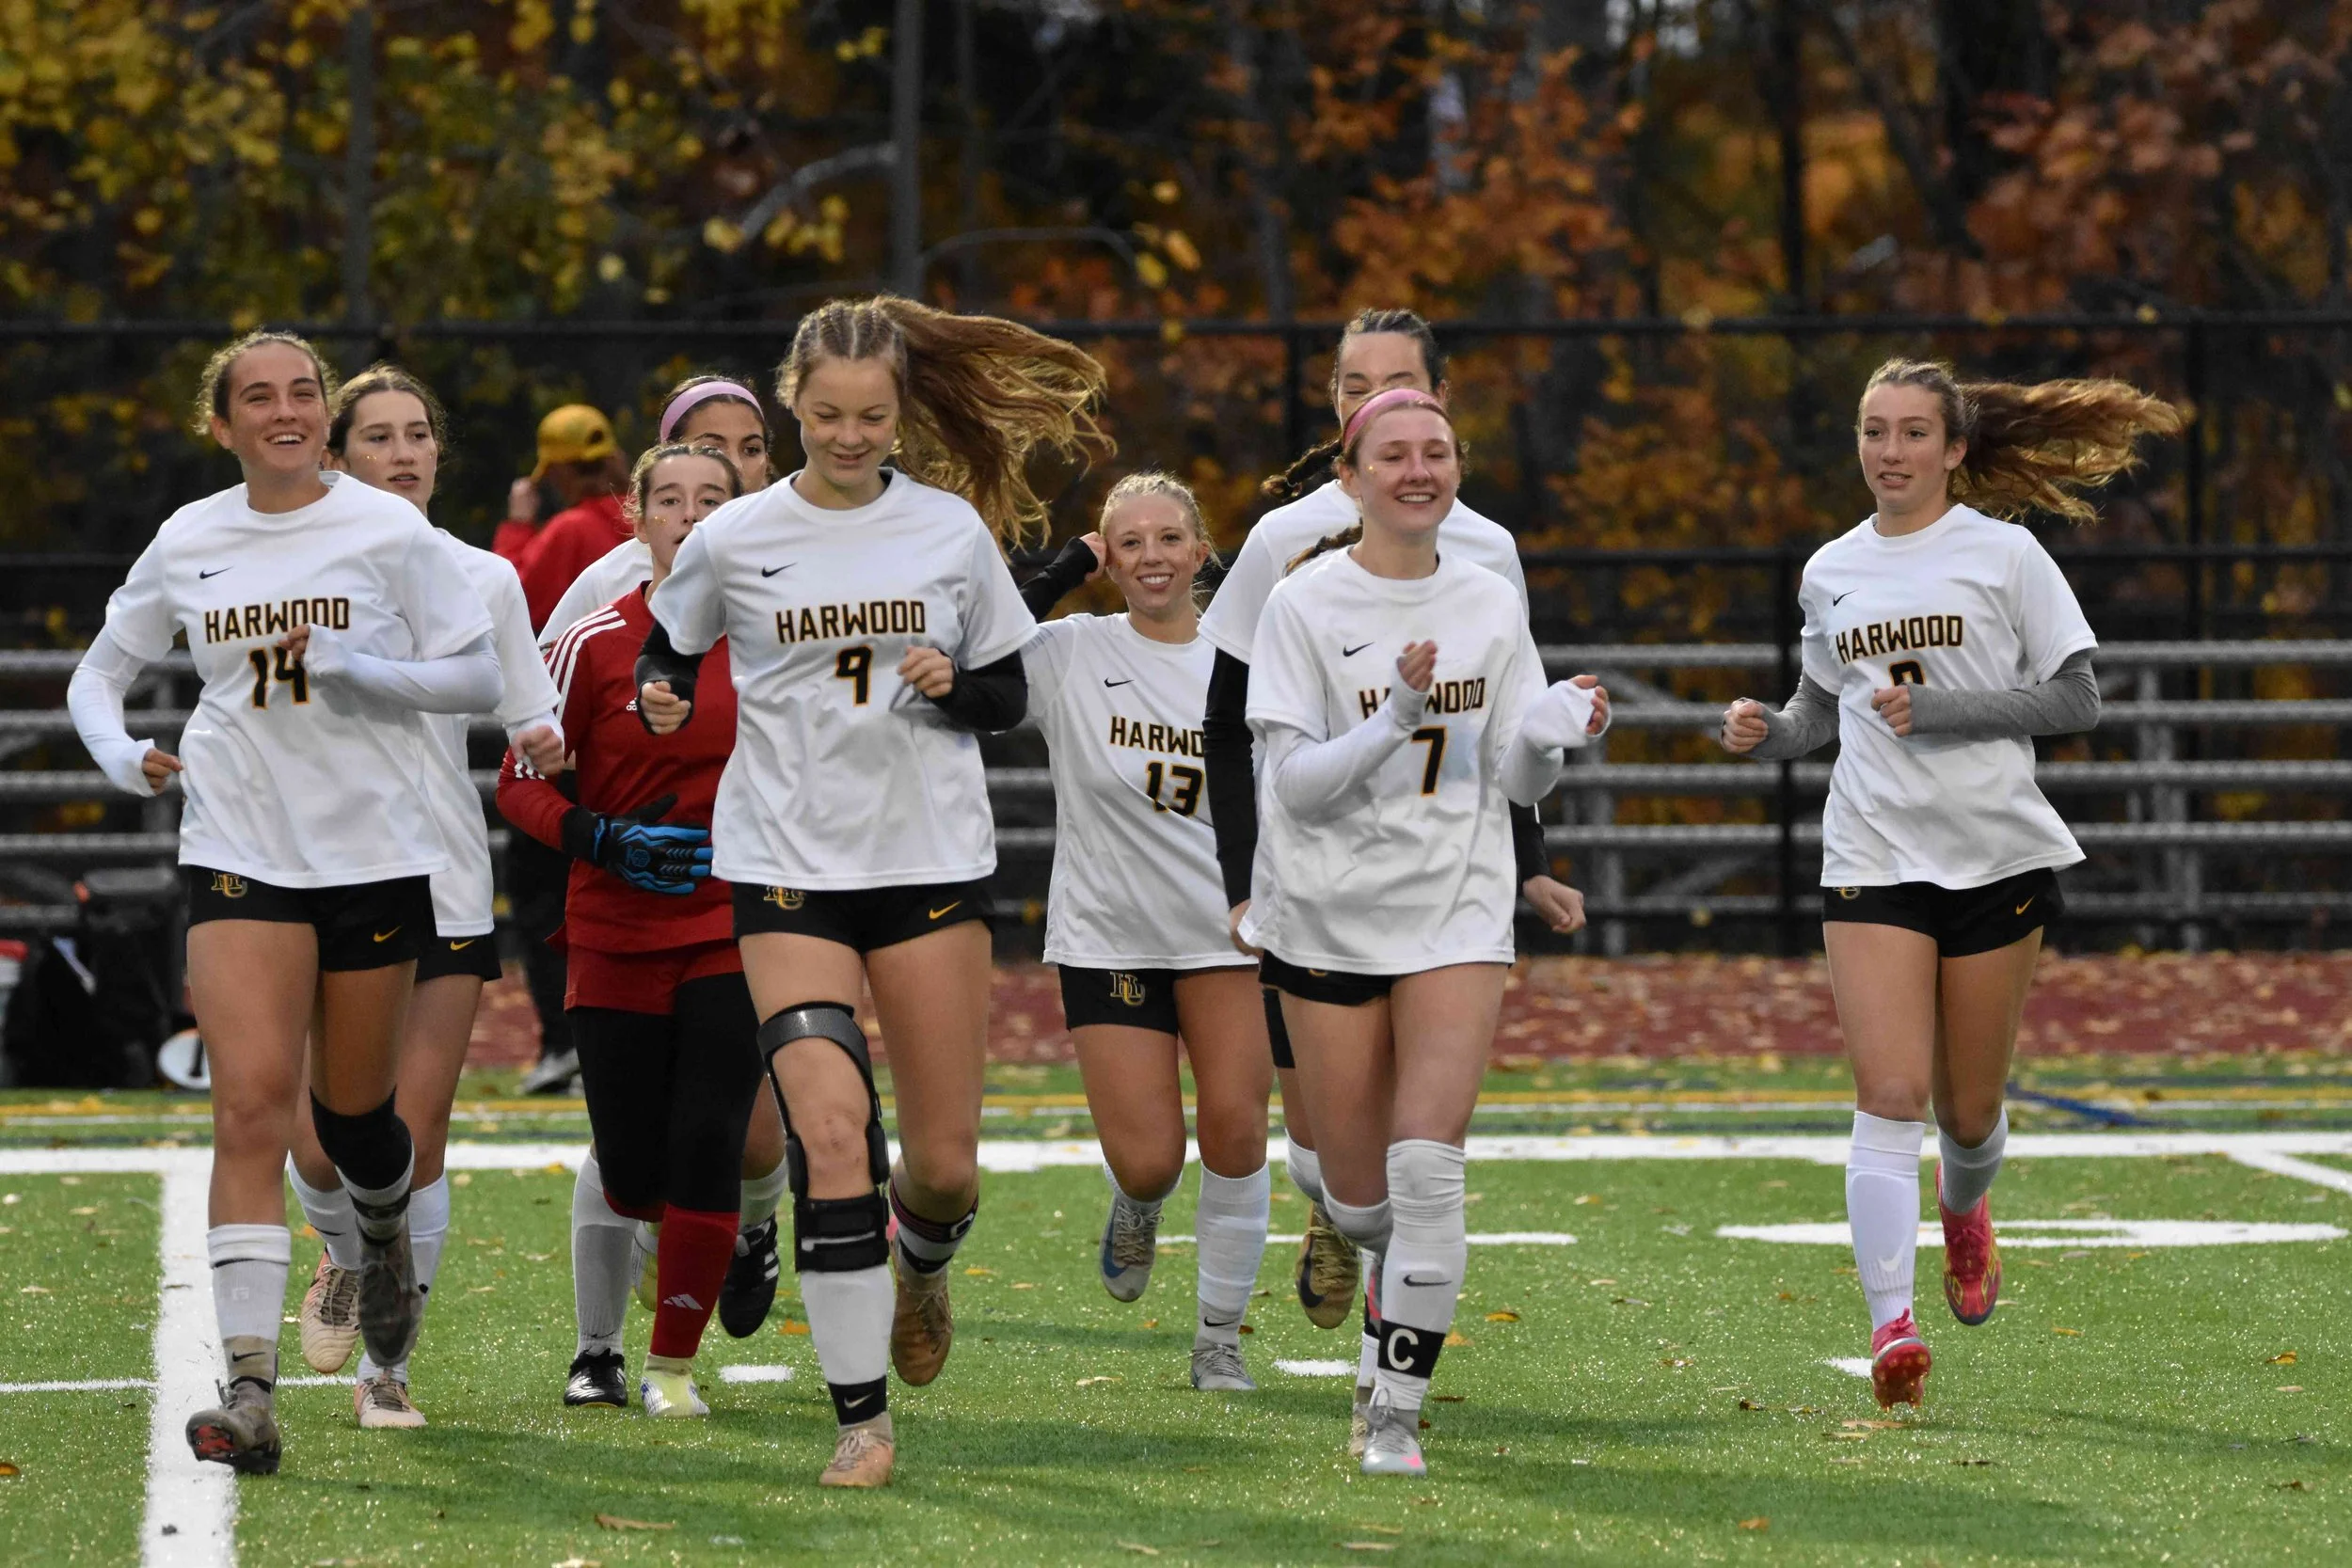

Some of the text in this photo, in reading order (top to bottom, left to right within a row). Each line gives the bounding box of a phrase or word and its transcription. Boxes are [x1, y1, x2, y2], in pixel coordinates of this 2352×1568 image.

[204, 597, 350, 644] HARWOOD
[775, 600, 926, 644] HARWOOD
[1836, 615, 1963, 664] HARWOOD
[248, 644, 310, 710] 14
[834, 643, 874, 707] 9
[1359, 676, 1486, 721] HWOOD
[1109, 716, 1205, 758] HARWO
[1410, 725, 1449, 797] 7
[1146, 760, 1205, 817] 13
[1387, 1327, 1420, 1371] C
